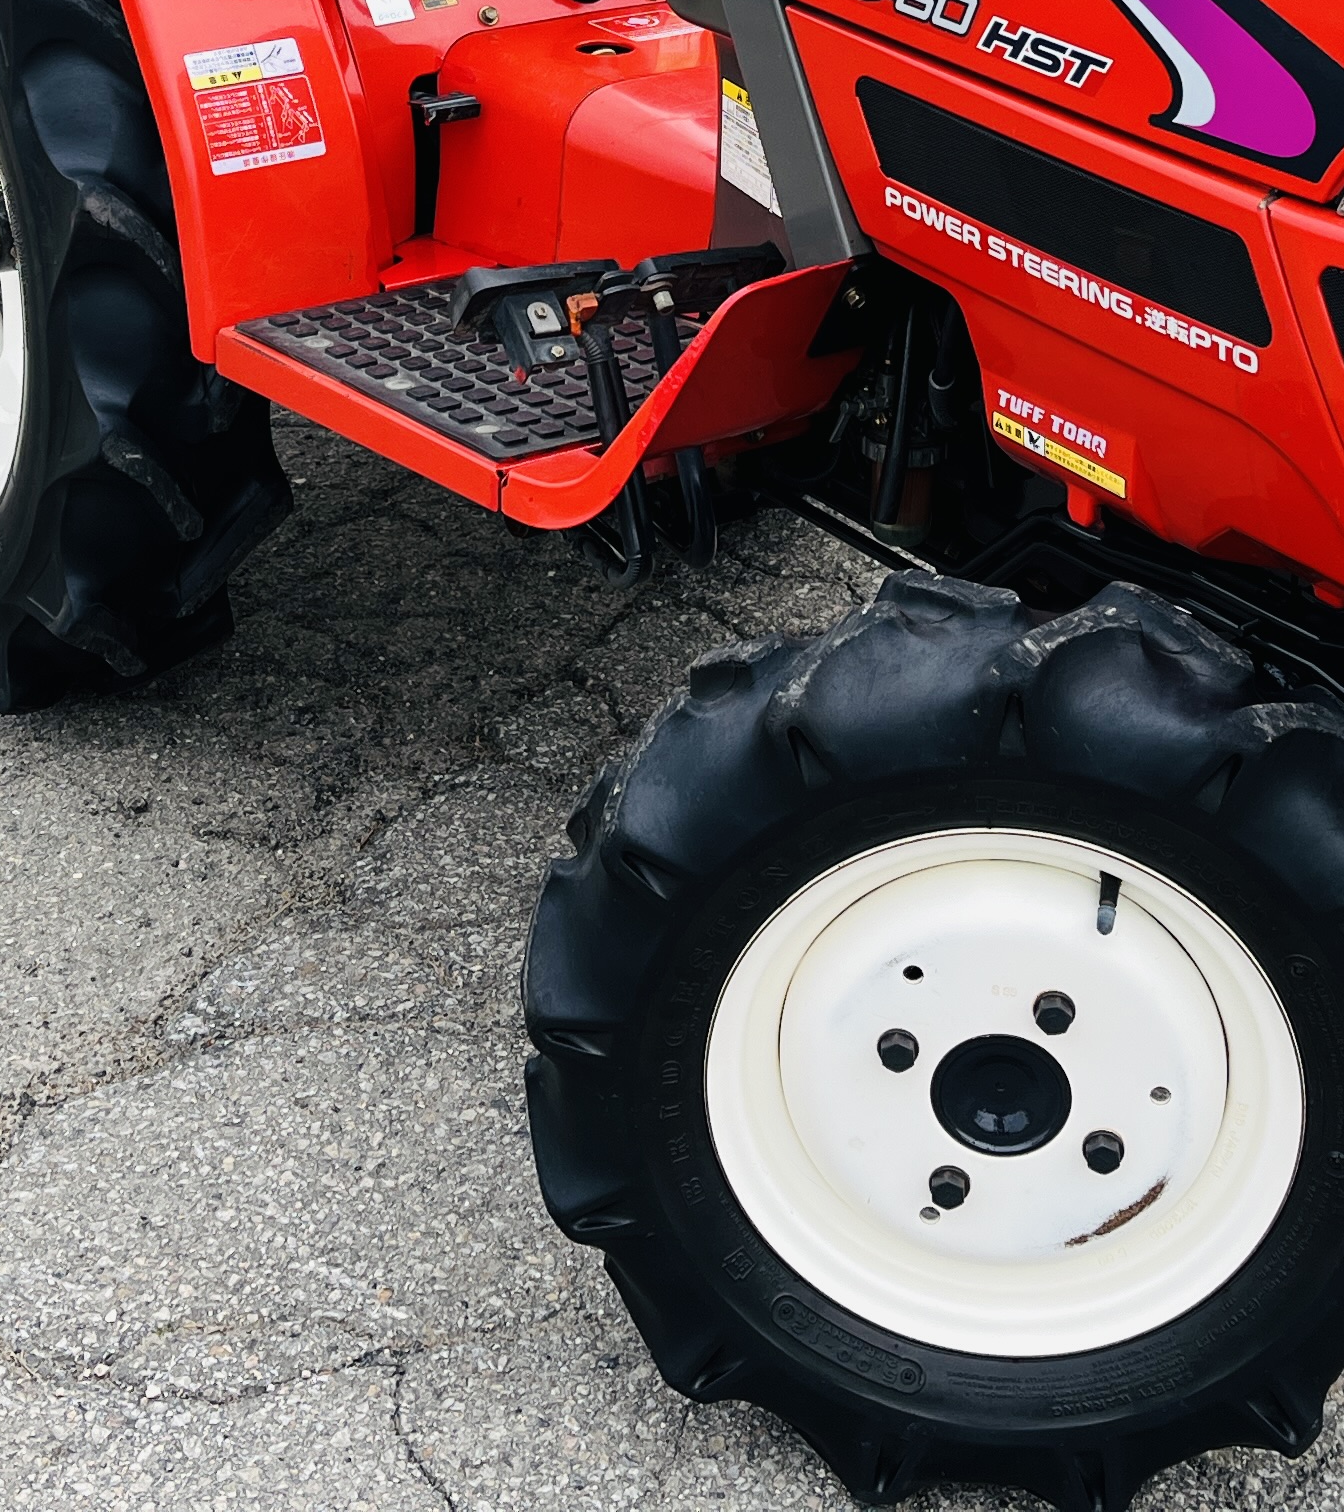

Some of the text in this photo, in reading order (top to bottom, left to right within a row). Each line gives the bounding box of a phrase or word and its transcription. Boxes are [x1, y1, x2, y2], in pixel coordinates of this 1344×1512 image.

[976, 15, 1114, 88] HST
[884, 186, 982, 251] POWER
[997, 389, 1107, 459] TUFF TORQ
[659, 835, 832, 1207] BRIDGESTONE
